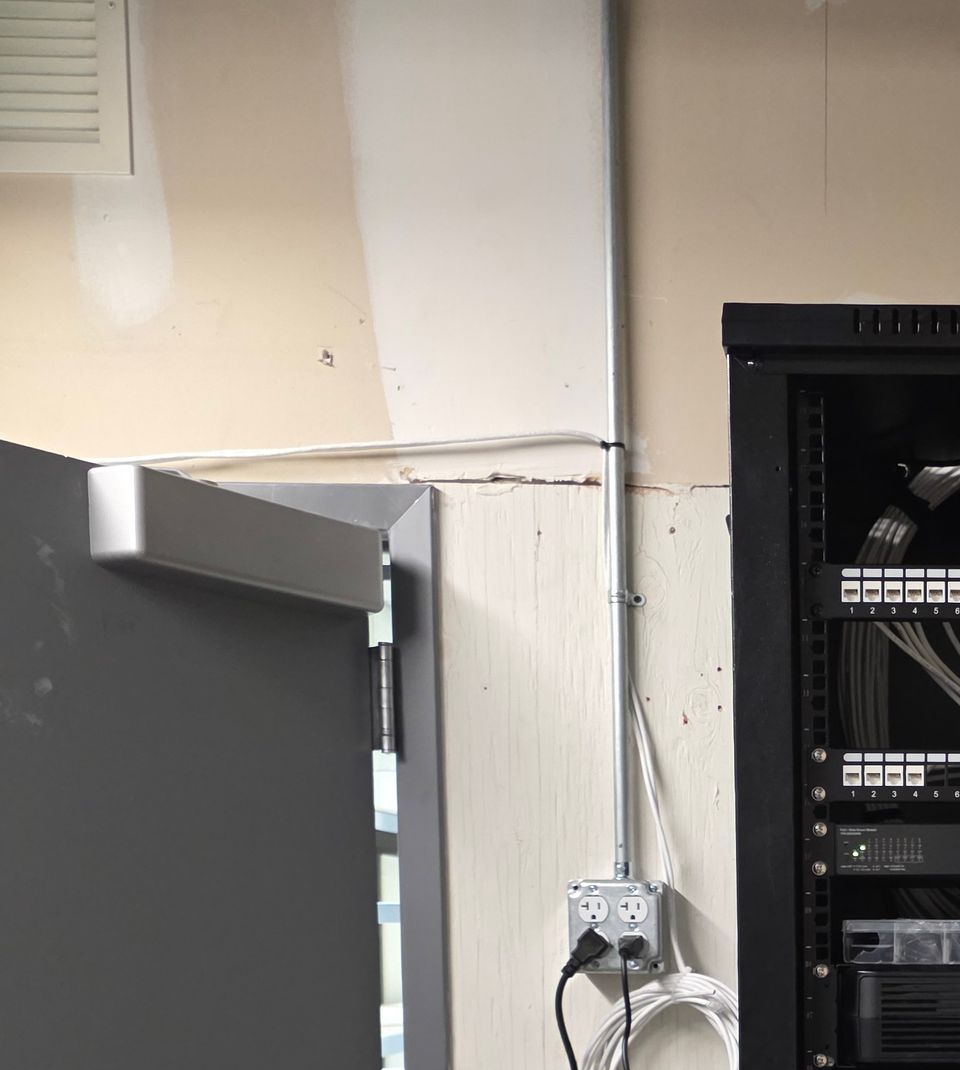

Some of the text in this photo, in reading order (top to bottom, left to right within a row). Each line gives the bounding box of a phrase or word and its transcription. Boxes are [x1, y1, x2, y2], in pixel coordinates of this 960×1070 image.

[849, 606, 854, 614] 1
[869, 606, 876, 615] 2
[890, 606, 897, 615] 3
[912, 607, 918, 615] 4
[933, 606, 939, 615] 5
[954, 607, 960, 615] 6
[851, 790, 855, 798] 1
[871, 790, 877, 798] 2
[891, 790, 898, 798] 3
[912, 790, 918, 798] 4
[933, 790, 939, 798] 5
[954, 790, 960, 798] 6
